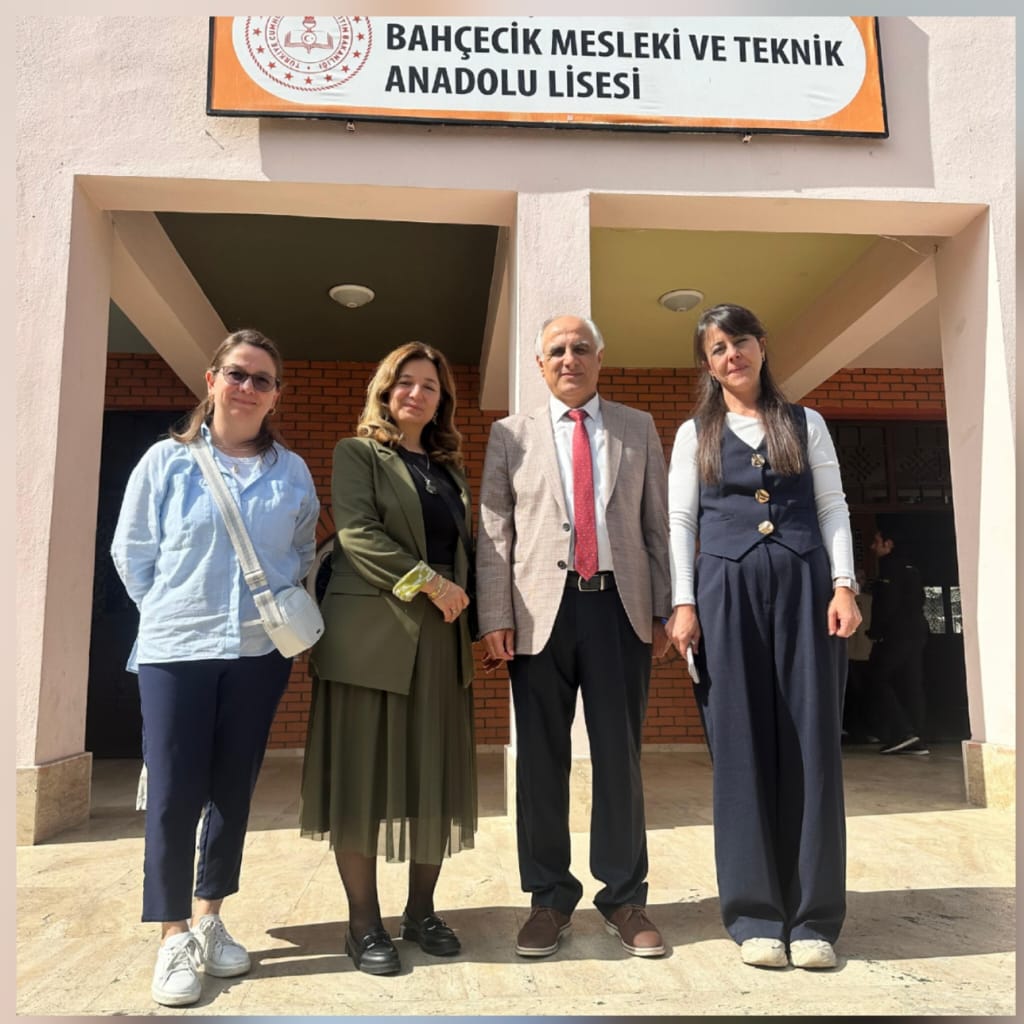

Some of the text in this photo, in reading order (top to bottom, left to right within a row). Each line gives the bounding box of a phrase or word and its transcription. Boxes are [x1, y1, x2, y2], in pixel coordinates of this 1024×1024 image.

[386, 21, 844, 67] BAHÇECİK MESLEKİ VE TEKNİK
[385, 65, 641, 100] ANADOLU LİSESİ
